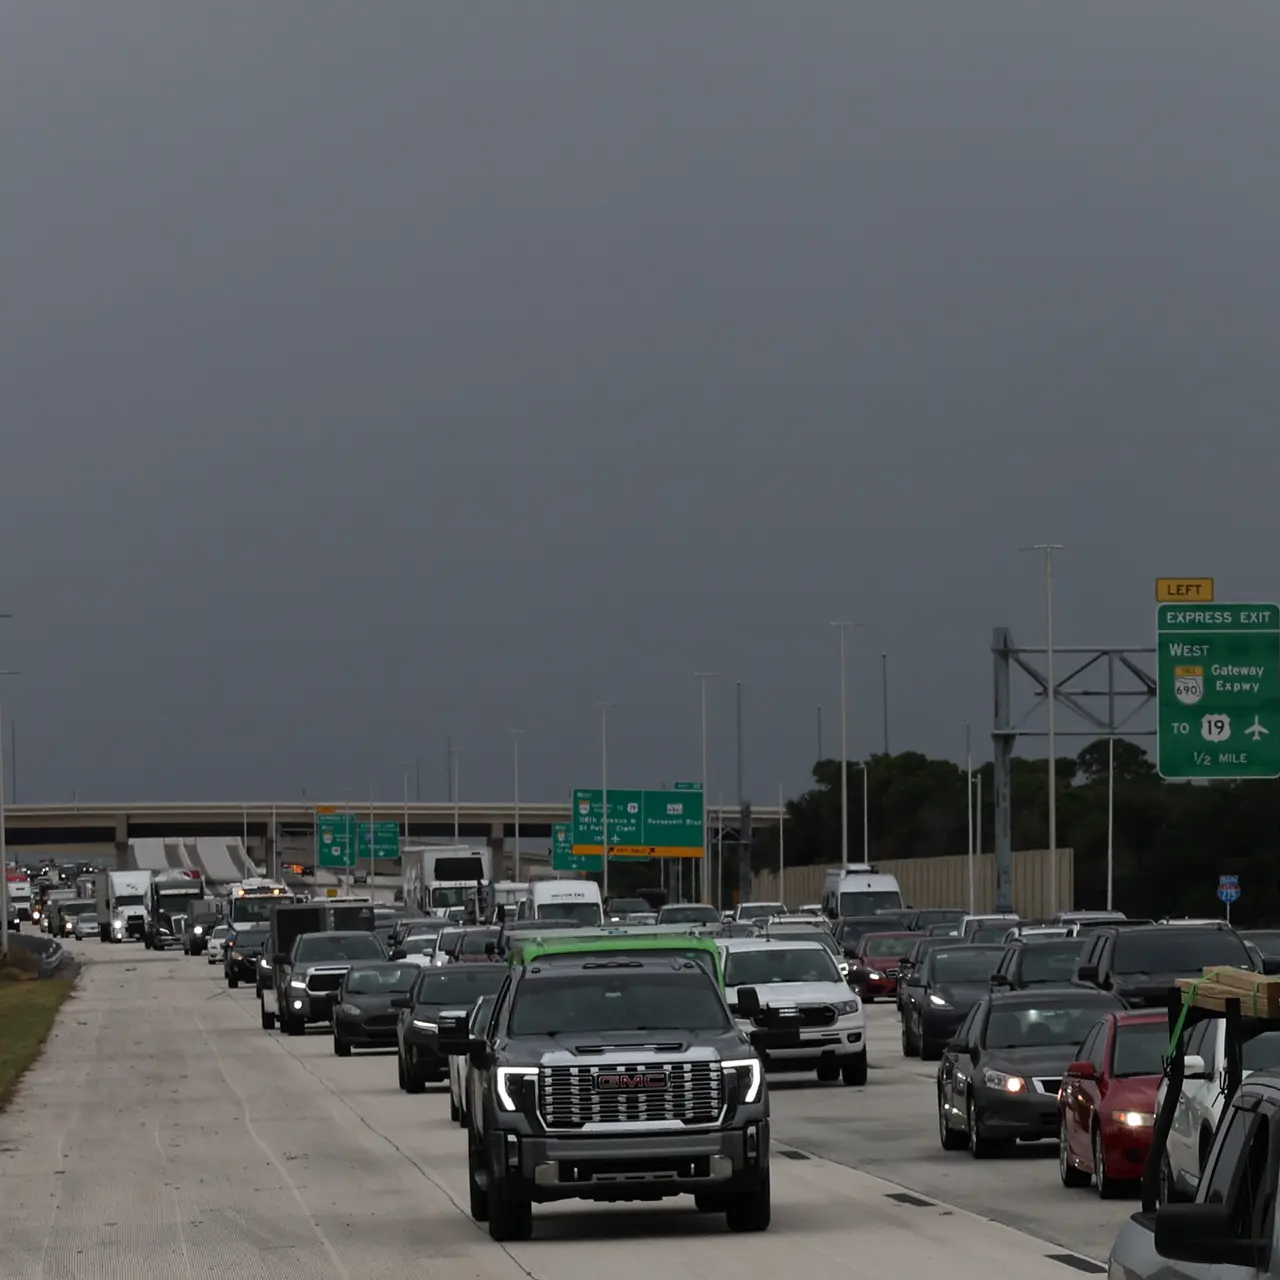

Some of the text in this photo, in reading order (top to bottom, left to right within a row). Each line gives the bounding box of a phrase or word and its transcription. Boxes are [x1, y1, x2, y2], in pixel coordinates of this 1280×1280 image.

[1167, 585, 1202, 595] LEFT
[1167, 612, 1271, 623] EXPRESS EXIT
[1211, 665, 1263, 678] Gateway
[1176, 686, 1196, 695] 690
[1216, 681, 1259, 692] Expwy
[1172, 720, 1224, 735] TO 19
[1219, 754, 1247, 763] MILE
[600, 1074, 666, 1088] GMC
